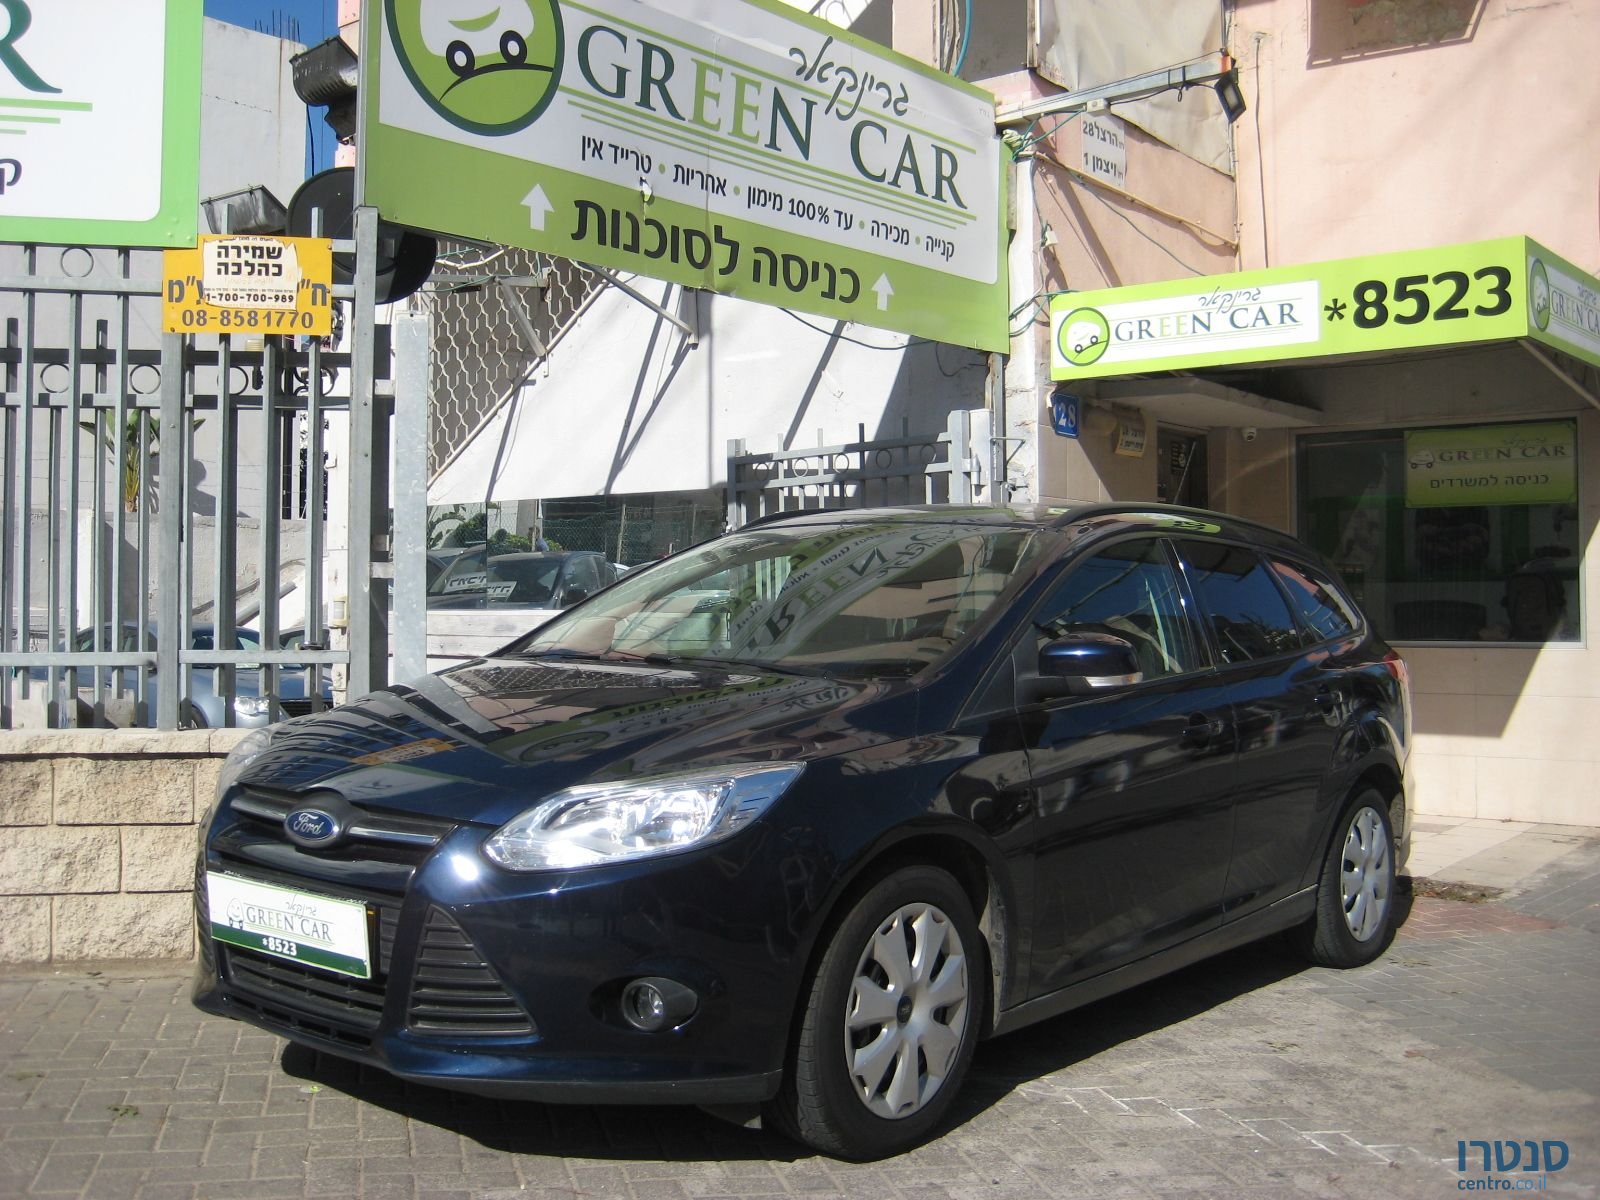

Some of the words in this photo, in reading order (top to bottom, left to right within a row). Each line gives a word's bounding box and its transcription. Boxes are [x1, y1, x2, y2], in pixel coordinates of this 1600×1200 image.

[789, 36, 909, 121] גרינקאר
[578, 25, 818, 161] GREEN
[851, 120, 968, 209] CAR
[581, 136, 603, 161] אין
[608, 143, 652, 174] טרייד
[1083, 152, 1089, 166] 1
[1092, 155, 1117, 177] ויצמן
[673, 164, 727, 196] אחריות
[747, 186, 783, 211] מימון
[788, 198, 829, 224] 100%
[833, 210, 853, 230] עד
[871, 220, 910, 245] מכירה
[570, 200, 740, 276] לסוכנות
[926, 236, 955, 262] קנייה
[217, 245, 283, 260] שמירה
[217, 260, 283, 277] כהלכה
[753, 246, 860, 304] כניסה
[206, 292, 294, 303] 1-700-700-989
[1551, 290, 1584, 326] GREEN
[182, 309, 314, 329] 08-8581770
[1115, 311, 1214, 342] GREEN
[1229, 302, 1301, 330] CAR
[1058, 402, 1077, 428] 28
[1439, 448, 1512, 463] GREEN
[1522, 445, 1567, 459] CAR
[1430, 475, 1499, 489] למשרדים
[1504, 474, 1549, 486] כניסה
[293, 812, 325, 835] Ford
[246, 906, 295, 932] GREEN
[301, 918, 332, 942] CAR
